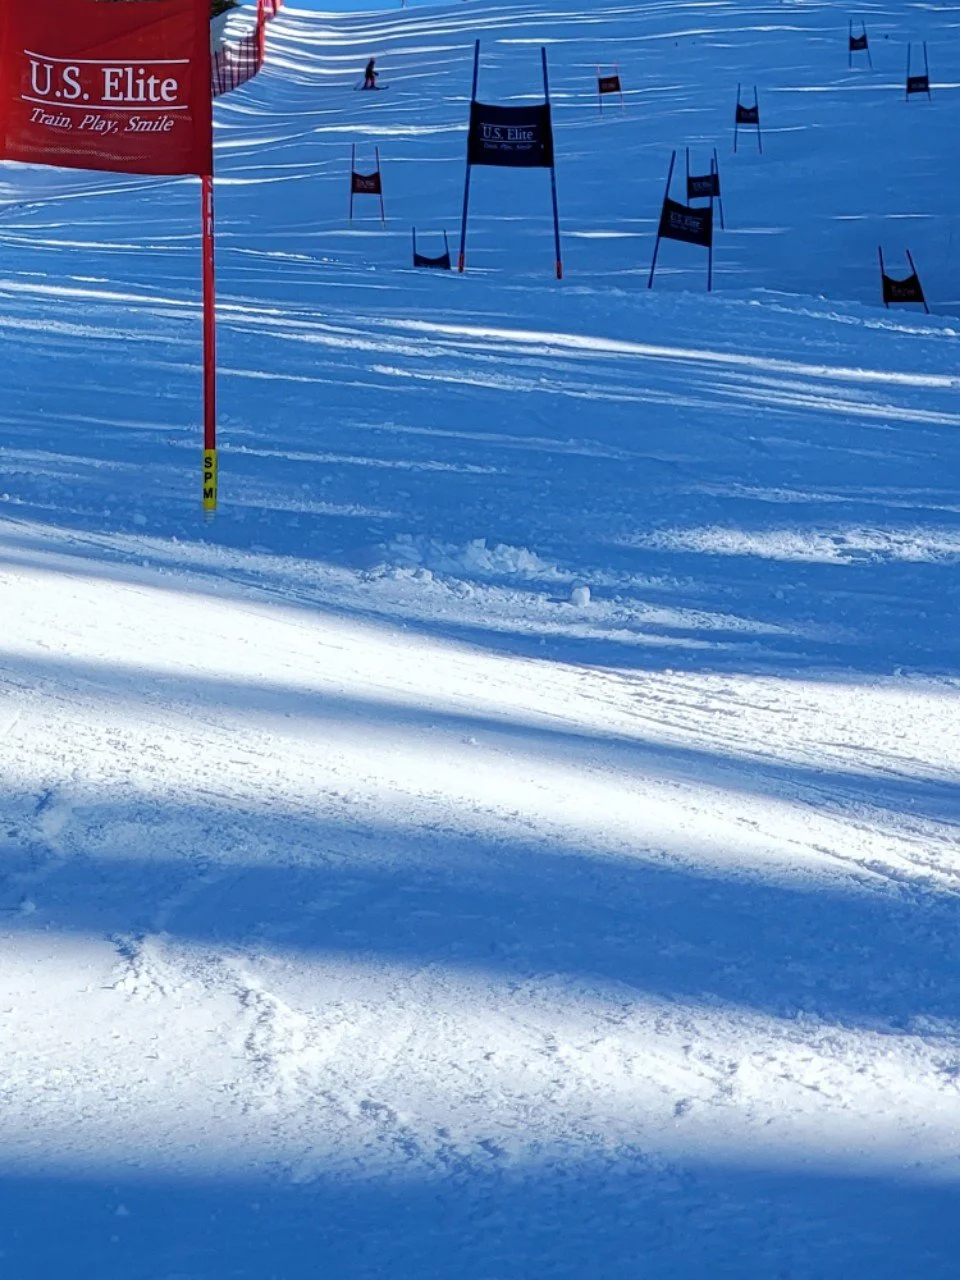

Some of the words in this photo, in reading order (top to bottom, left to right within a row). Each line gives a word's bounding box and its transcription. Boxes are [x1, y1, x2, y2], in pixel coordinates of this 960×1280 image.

[30, 60, 90, 101] U.S.
[101, 67, 178, 102] Elite
[29, 108, 74, 129] Train,
[78, 115, 120, 136] Play,
[124, 115, 175, 132] Smile
[483, 126, 504, 140] U.S.
[507, 128, 534, 141] Elite
[203, 457, 213, 498] SPM
